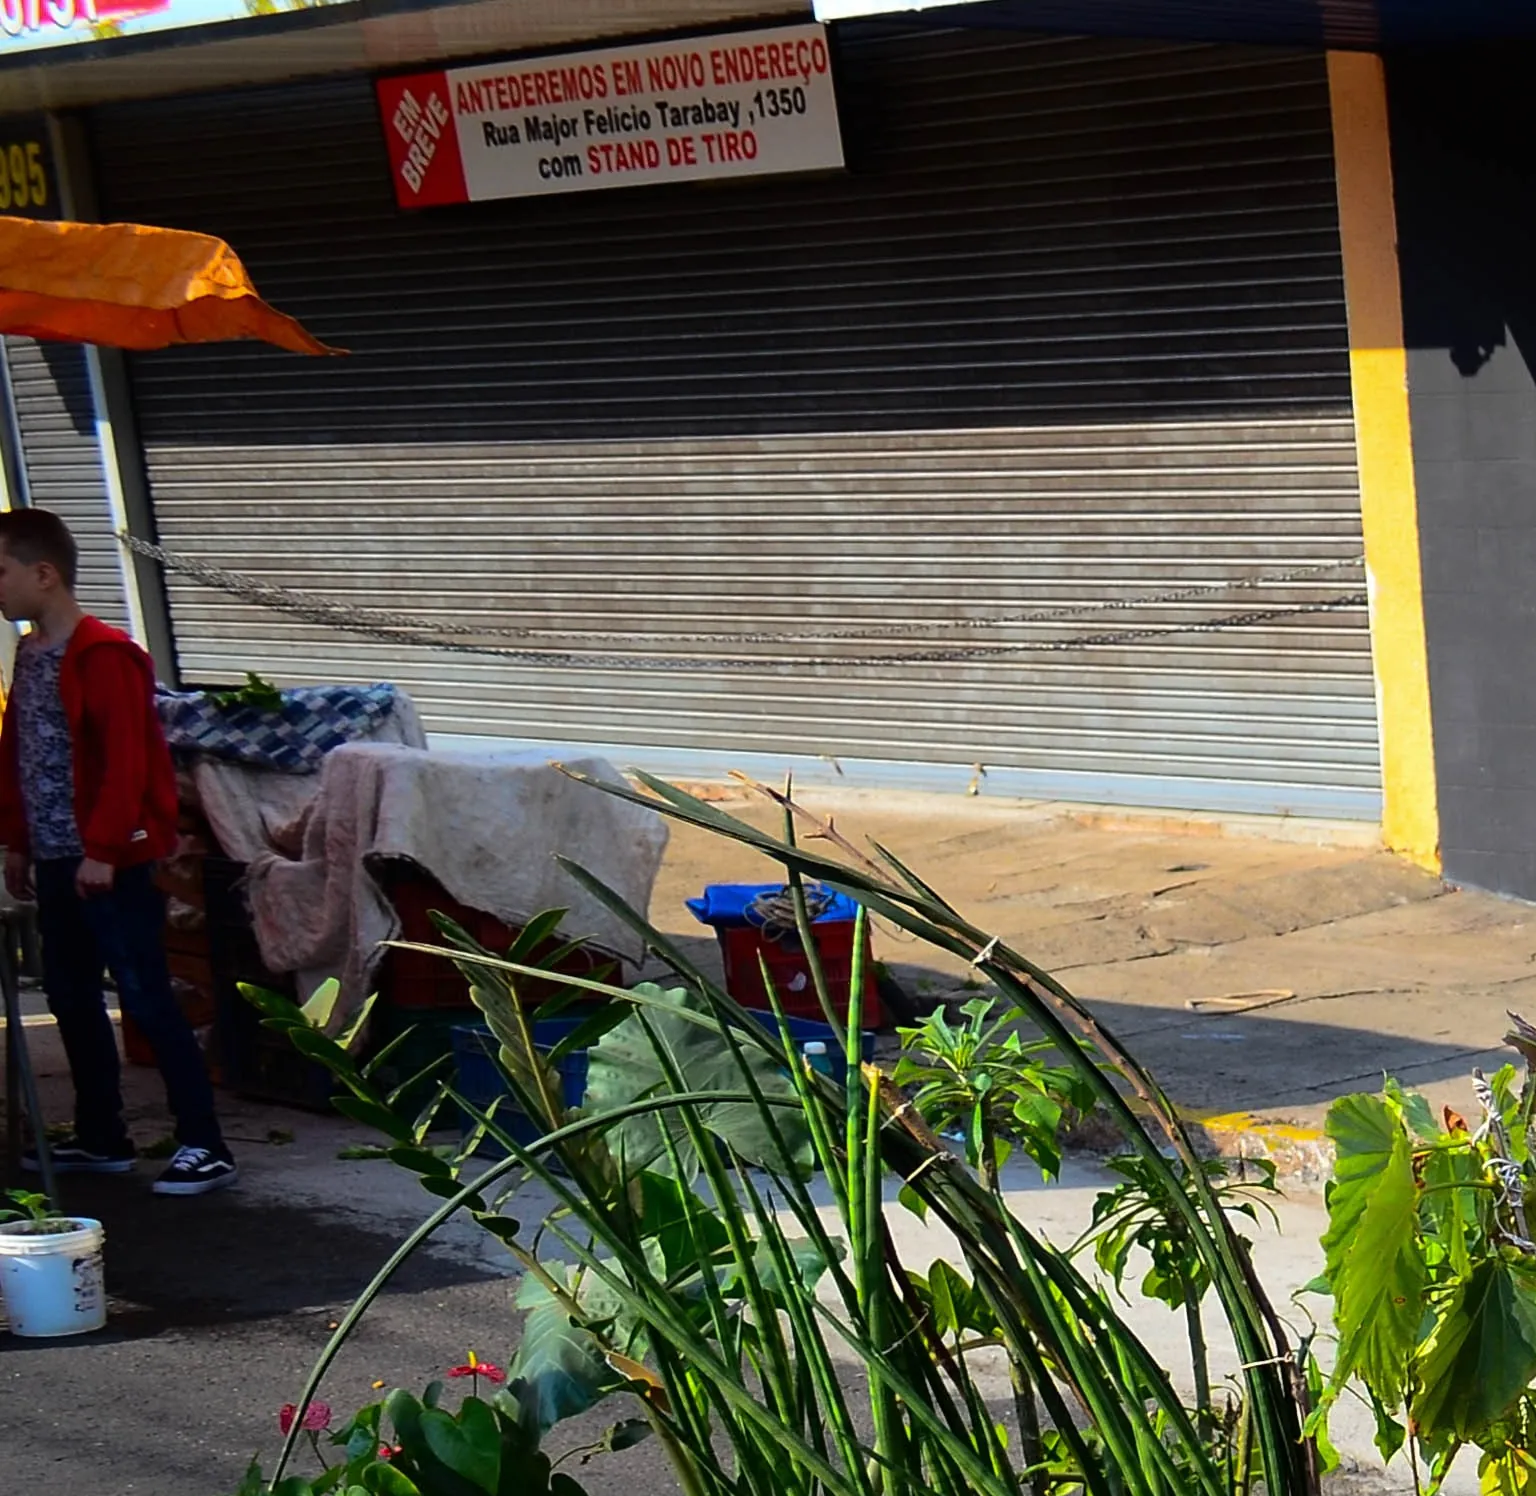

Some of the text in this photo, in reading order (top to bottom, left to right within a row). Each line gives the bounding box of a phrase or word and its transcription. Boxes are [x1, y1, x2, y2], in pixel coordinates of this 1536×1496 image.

[456, 38, 827, 115] ANTEDEREMOS EM NOVO ENDEREÇO
[392, 87, 422, 144] EM
[400, 91, 450, 194] BREVE
[482, 120, 521, 147] Rua
[524, 113, 579, 146] Major
[582, 102, 651, 136] Felício
[655, 97, 740, 128] Tarabay
[538, 130, 758, 179] com STAND DE TIRO
